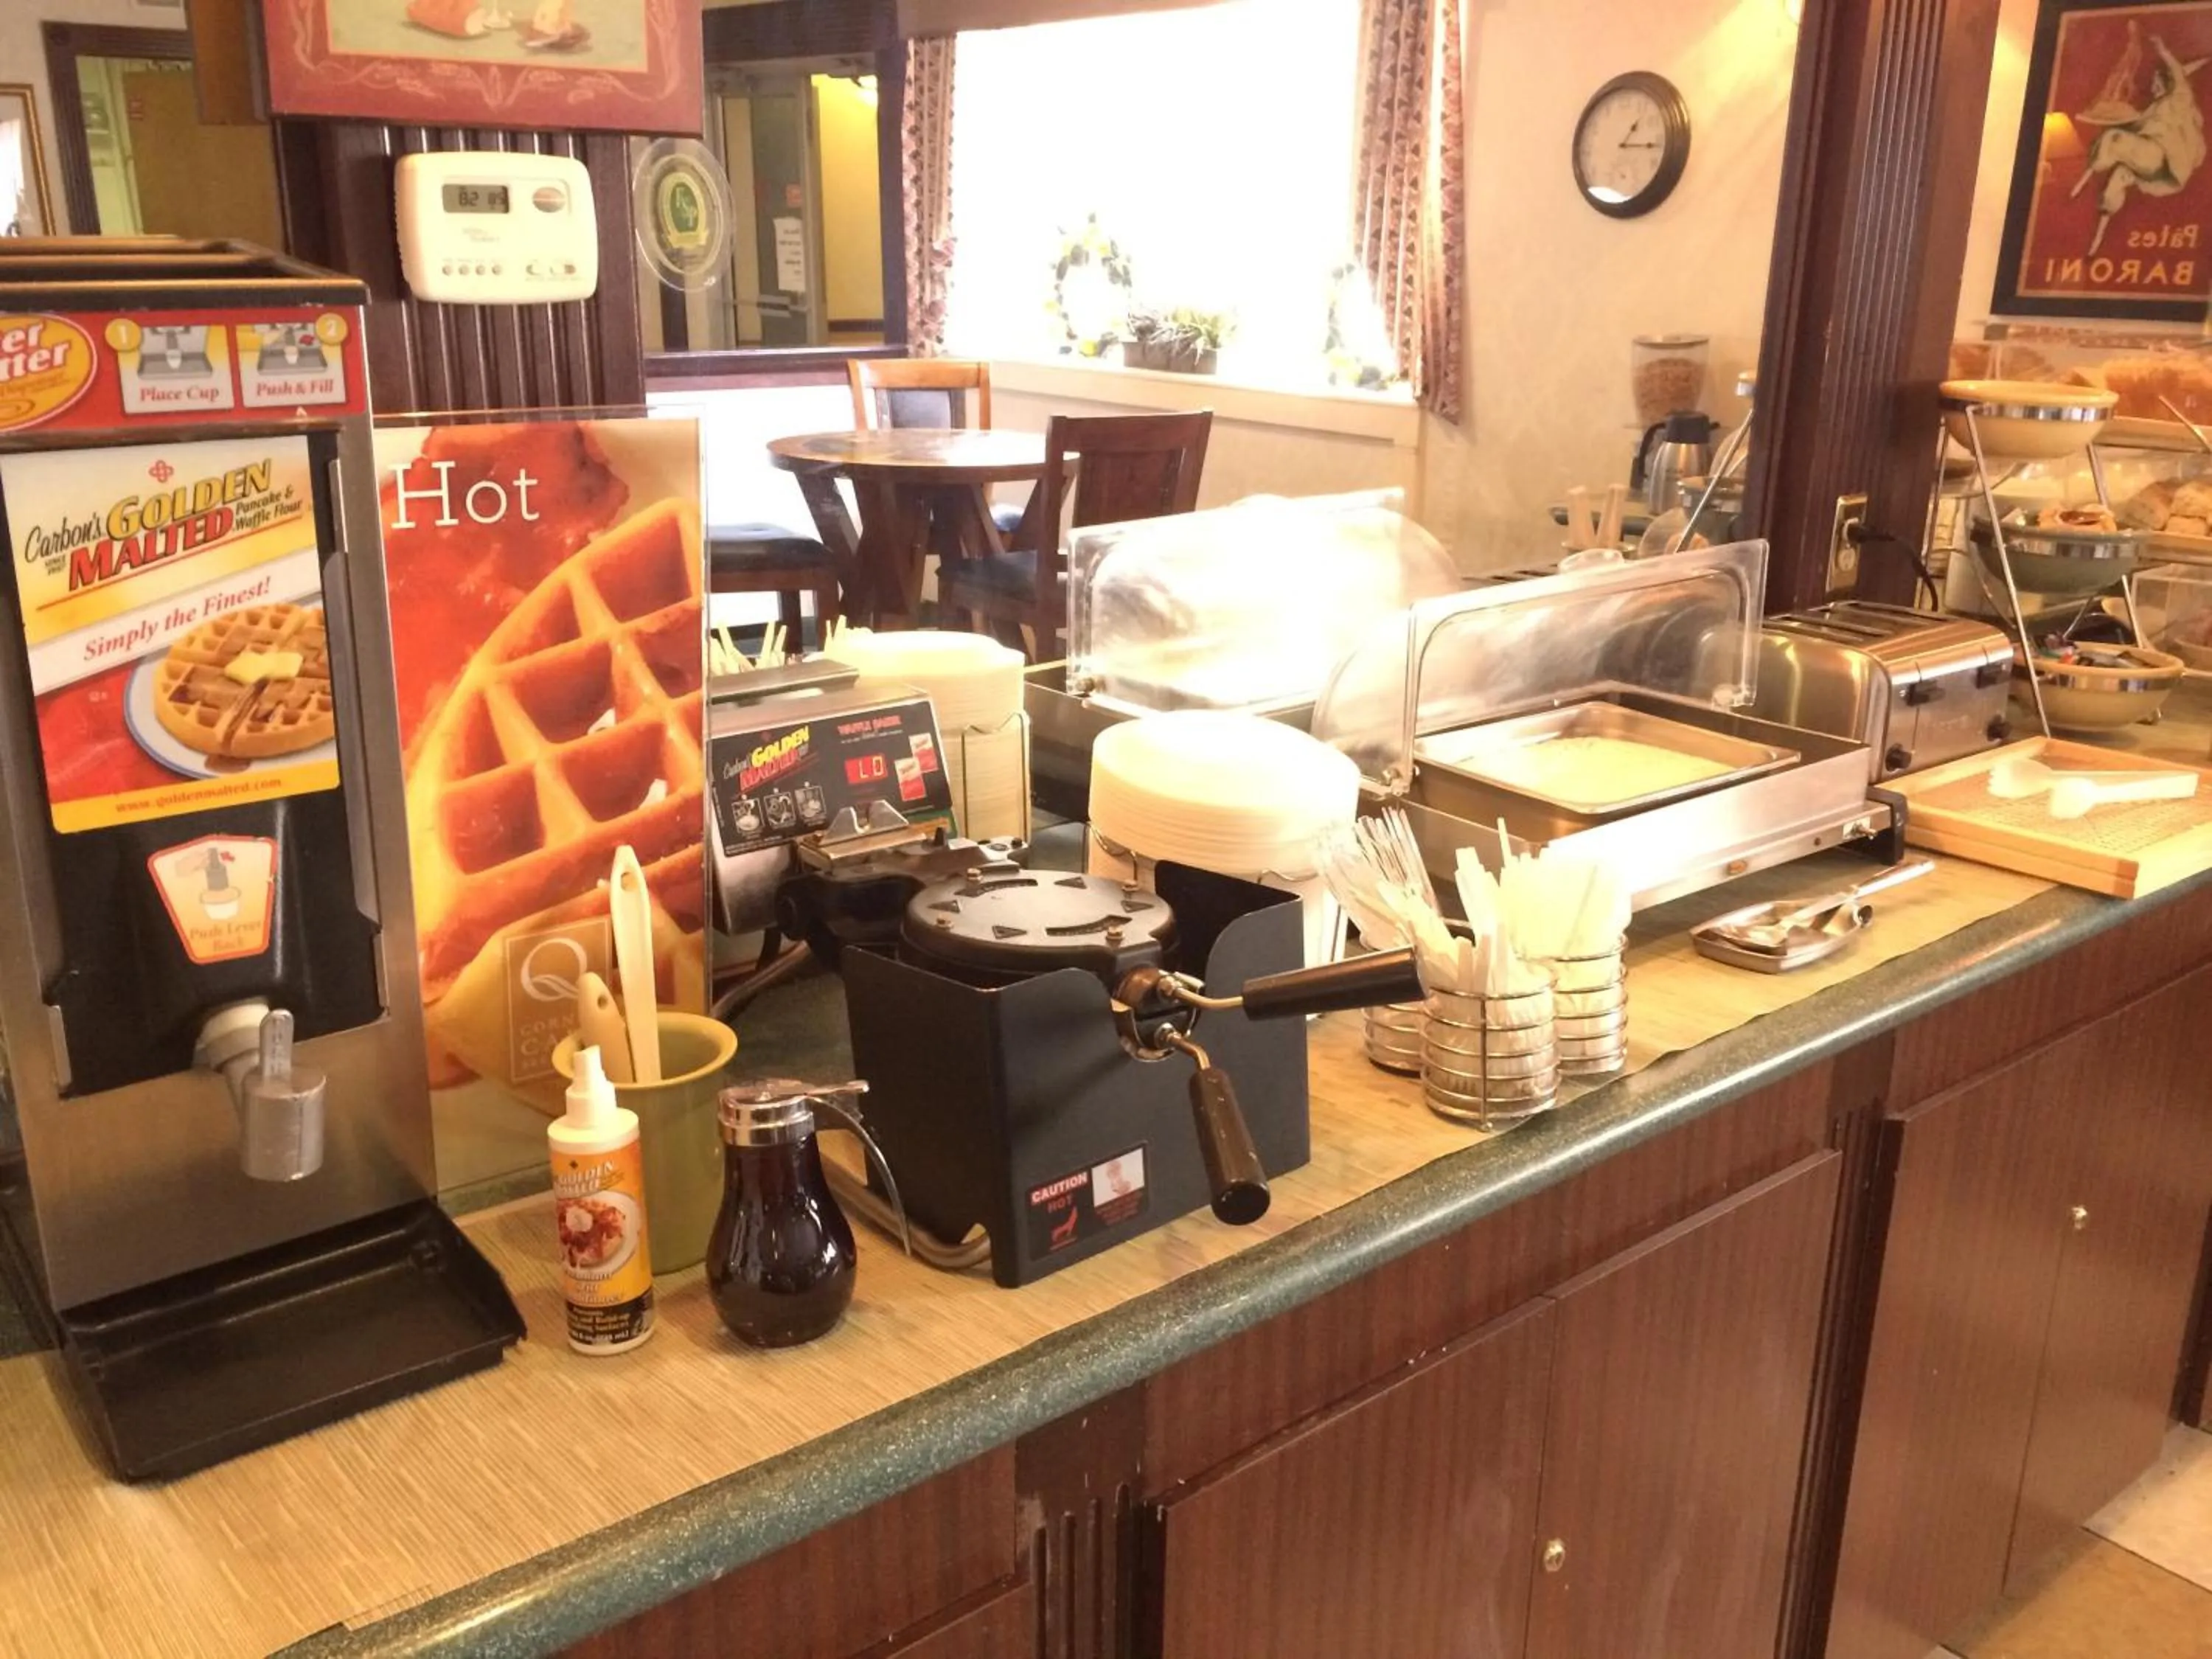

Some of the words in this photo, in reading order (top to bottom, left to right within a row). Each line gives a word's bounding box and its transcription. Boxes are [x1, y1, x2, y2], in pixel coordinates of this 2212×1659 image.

[117, 324, 128, 345] 1
[327, 319, 338, 337] 2
[139, 386, 182, 403] Place
[187, 384, 220, 403] Cup
[256, 382, 293, 397] Push
[296, 382, 307, 394] &
[310, 378, 334, 394] Fill
[24, 511, 102, 563] Carbon's
[106, 457, 271, 541] GOLDEN
[235, 491, 282, 515] Pancake
[284, 484, 294, 498] &
[387, 460, 540, 529] Hot
[234, 509, 271, 531] Waffle
[274, 498, 303, 518] Flour
[69, 506, 234, 591] MALTED
[83, 620, 159, 661] Simply
[164, 608, 198, 632] the
[203, 575, 271, 617] Finest!
[751, 725, 810, 768] GOLDEN
[1030, 1171, 1088, 1206] CAUTION
[1047, 1192, 1074, 1214] HOT
